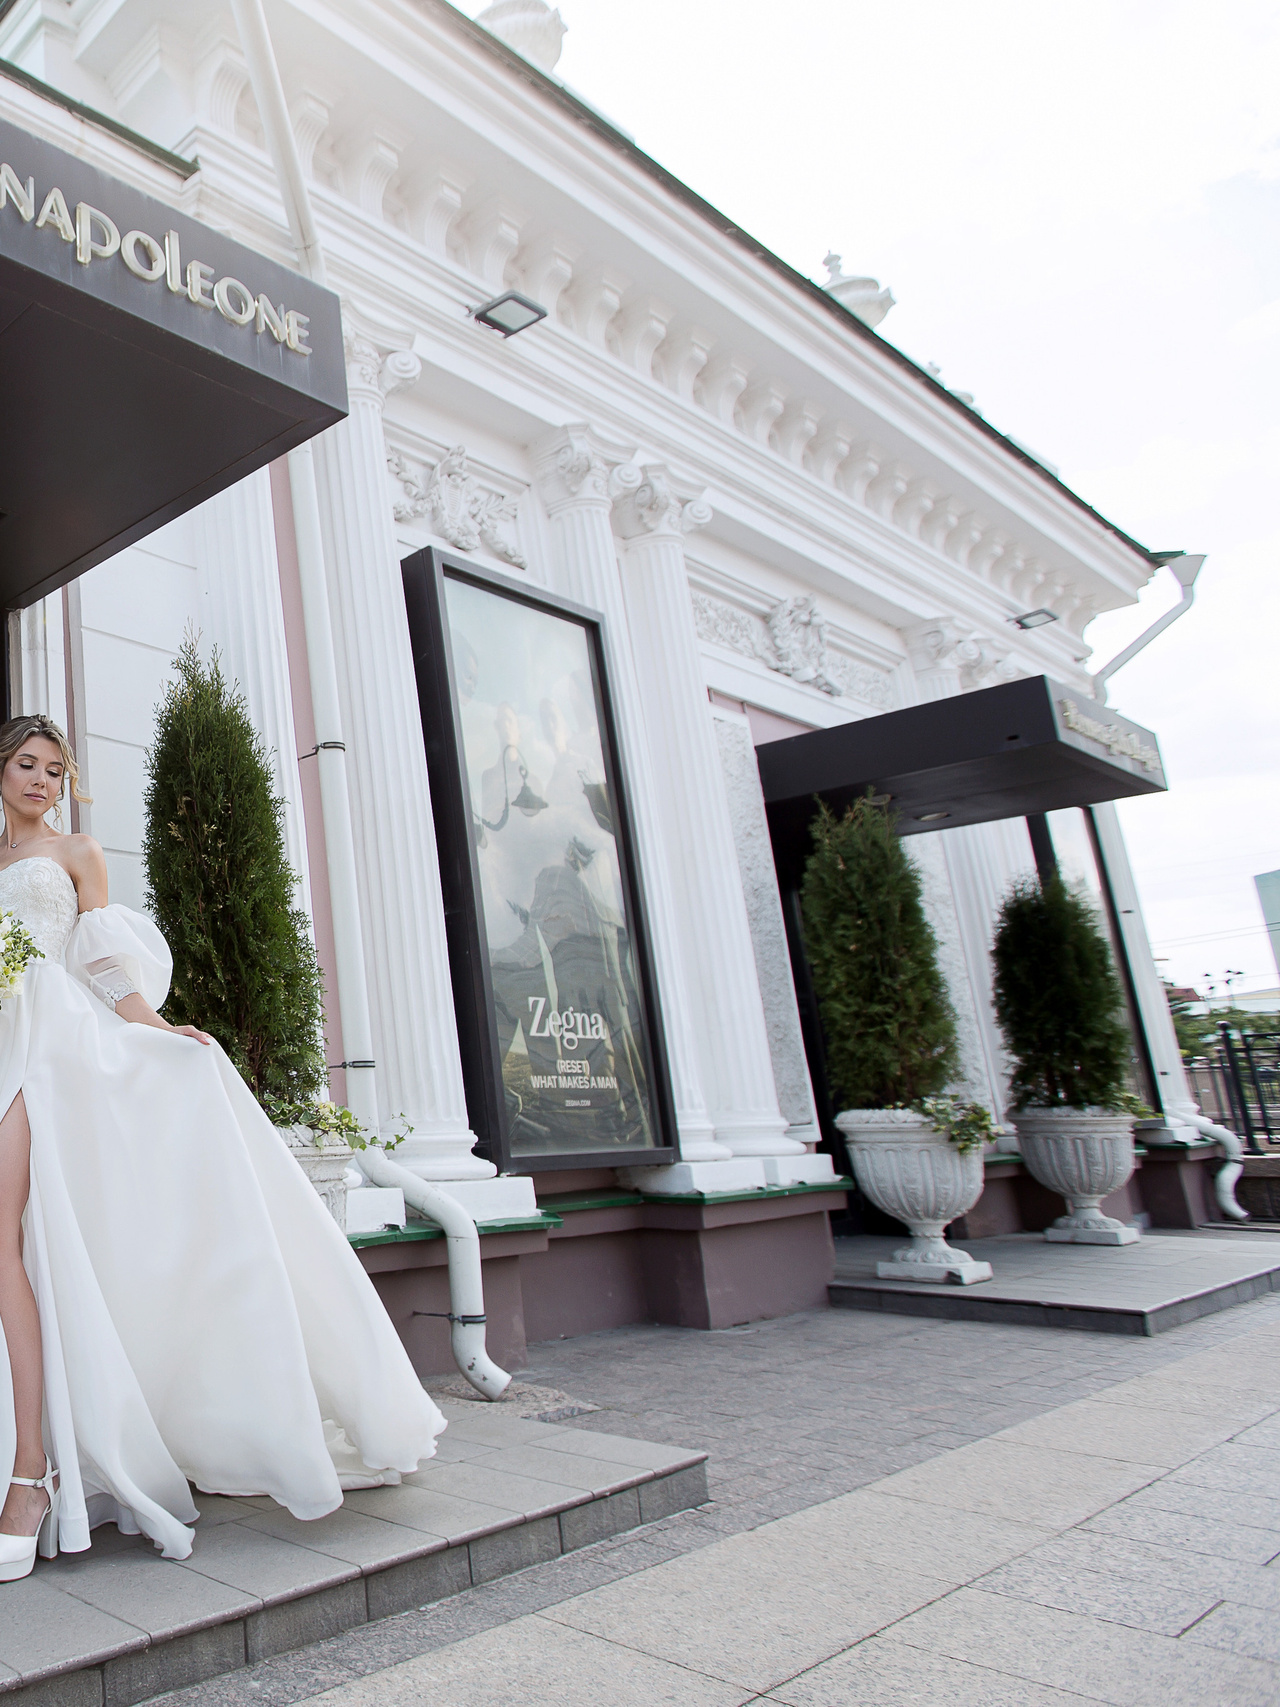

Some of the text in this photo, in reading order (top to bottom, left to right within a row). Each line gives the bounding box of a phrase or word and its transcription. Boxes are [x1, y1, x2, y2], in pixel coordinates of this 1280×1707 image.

[528, 996, 607, 1050] Zegna
[557, 1060, 590, 1075] (RESET)
[531, 1075, 618, 1090] WHAT MAKES A MAN
